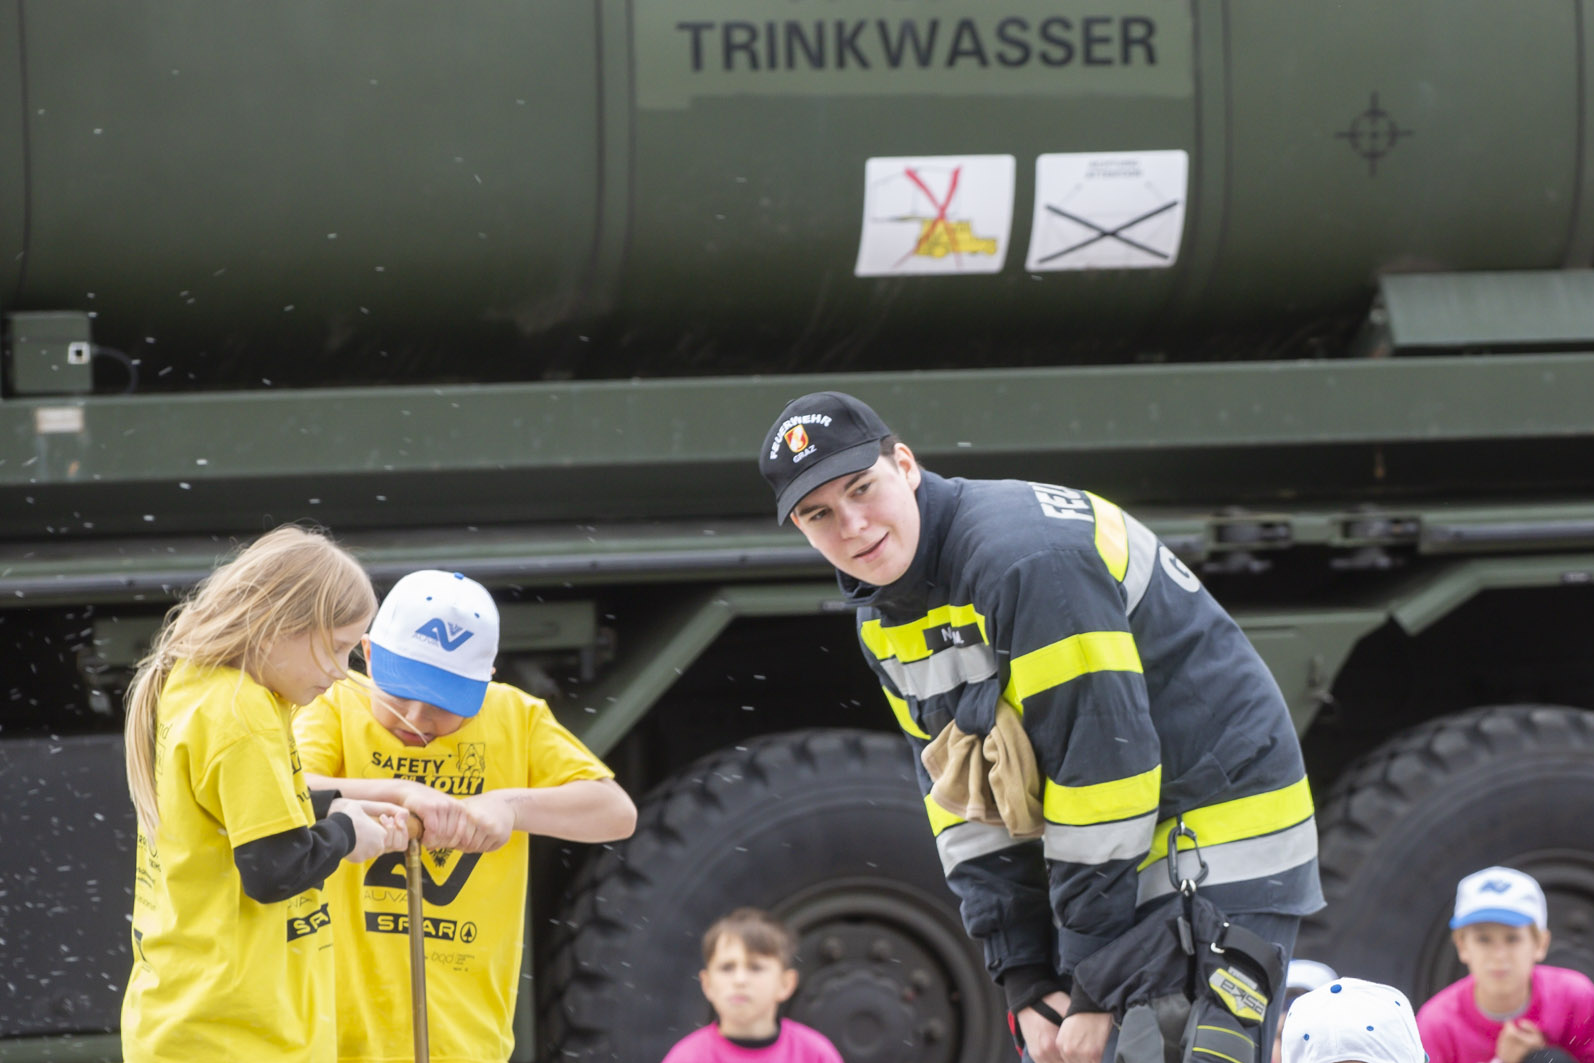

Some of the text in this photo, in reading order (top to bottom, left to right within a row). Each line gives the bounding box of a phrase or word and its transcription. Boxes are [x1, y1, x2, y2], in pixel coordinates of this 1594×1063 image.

[678, 16, 1158, 72] TRINKWASSER
[769, 413, 832, 460] FEUERWEHR
[793, 444, 817, 463] GRAZ
[371, 751, 445, 774] SAFETY
